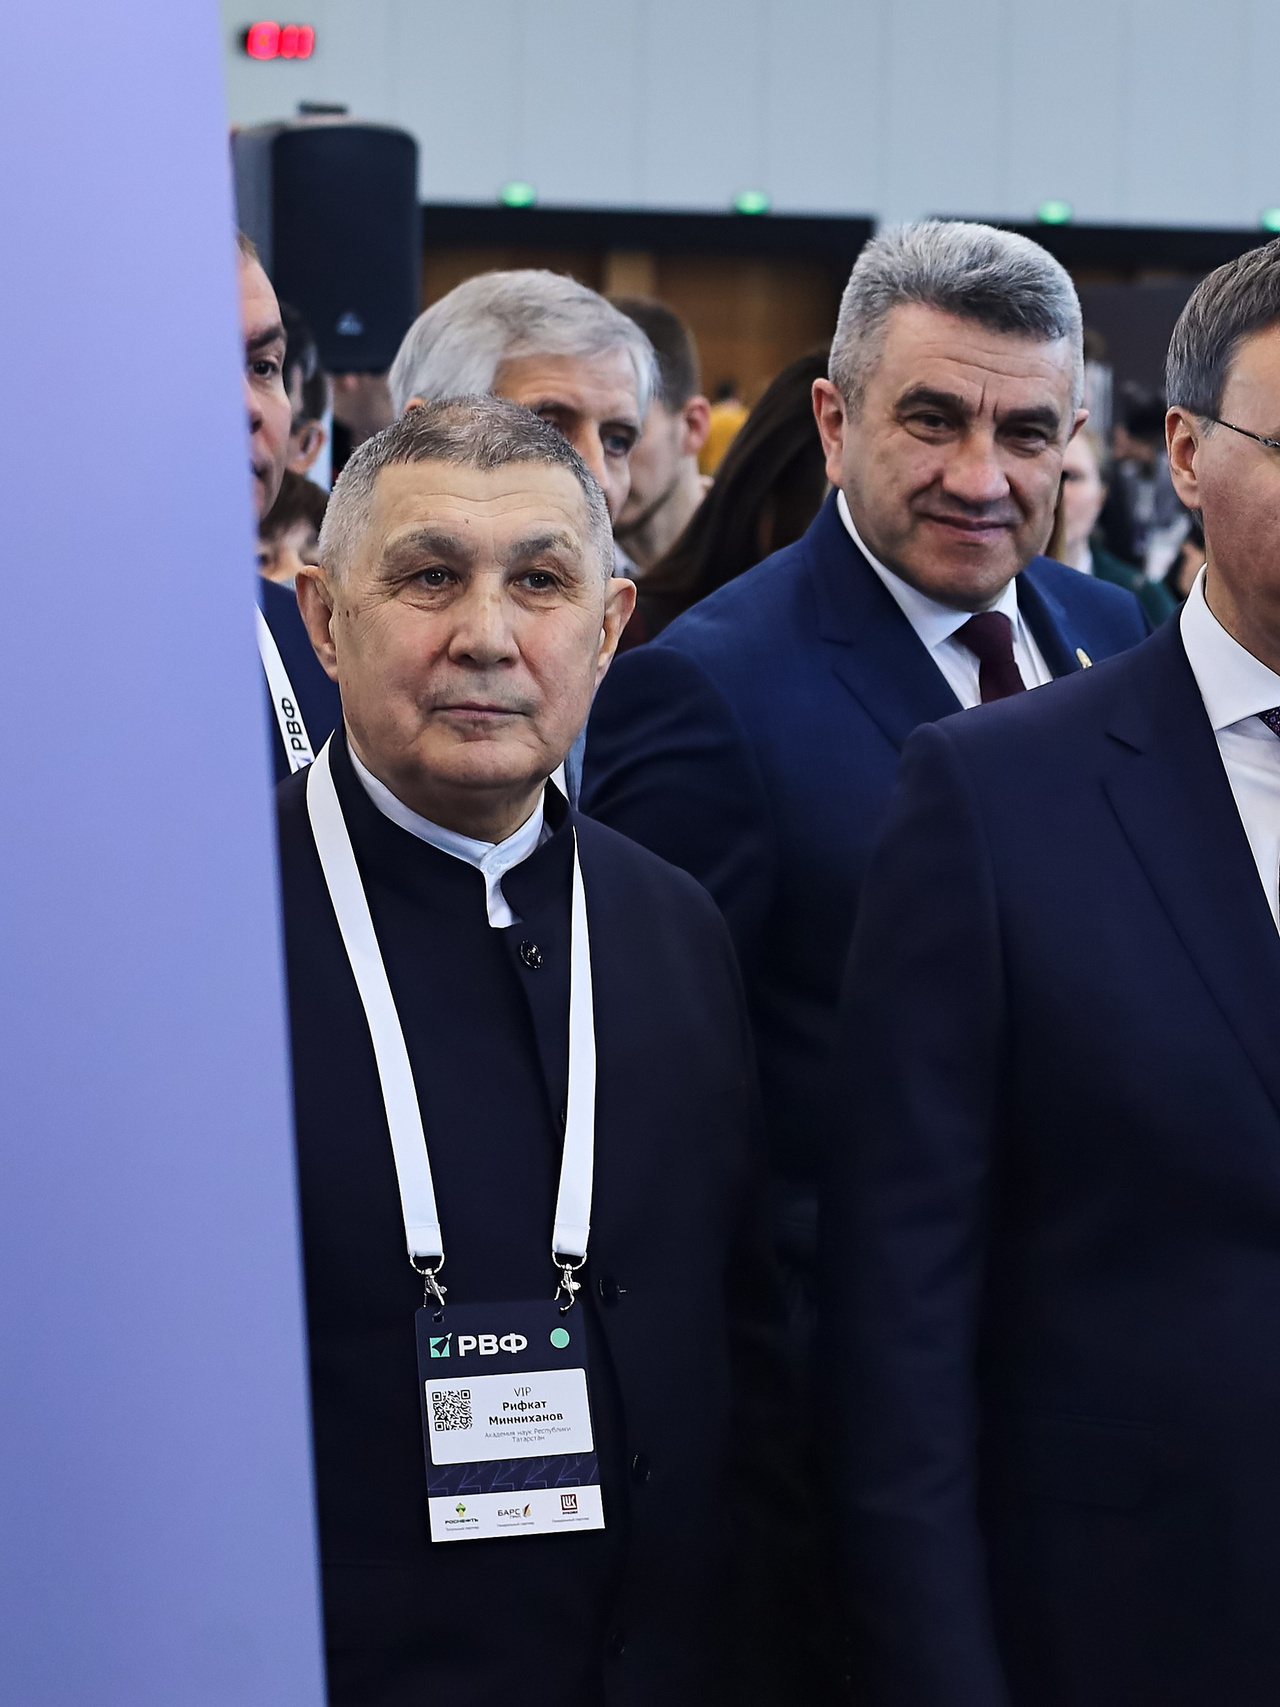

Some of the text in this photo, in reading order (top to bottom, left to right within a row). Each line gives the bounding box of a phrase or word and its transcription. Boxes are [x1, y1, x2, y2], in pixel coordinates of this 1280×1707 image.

[281, 697, 307, 751] РВФ
[458, 1333, 528, 1357] РВФ
[513, 1386, 532, 1397] VIP
[502, 1400, 547, 1412] Рифкат
[488, 1412, 564, 1426] Минниханов
[497, 1508, 521, 1517] БАРС
